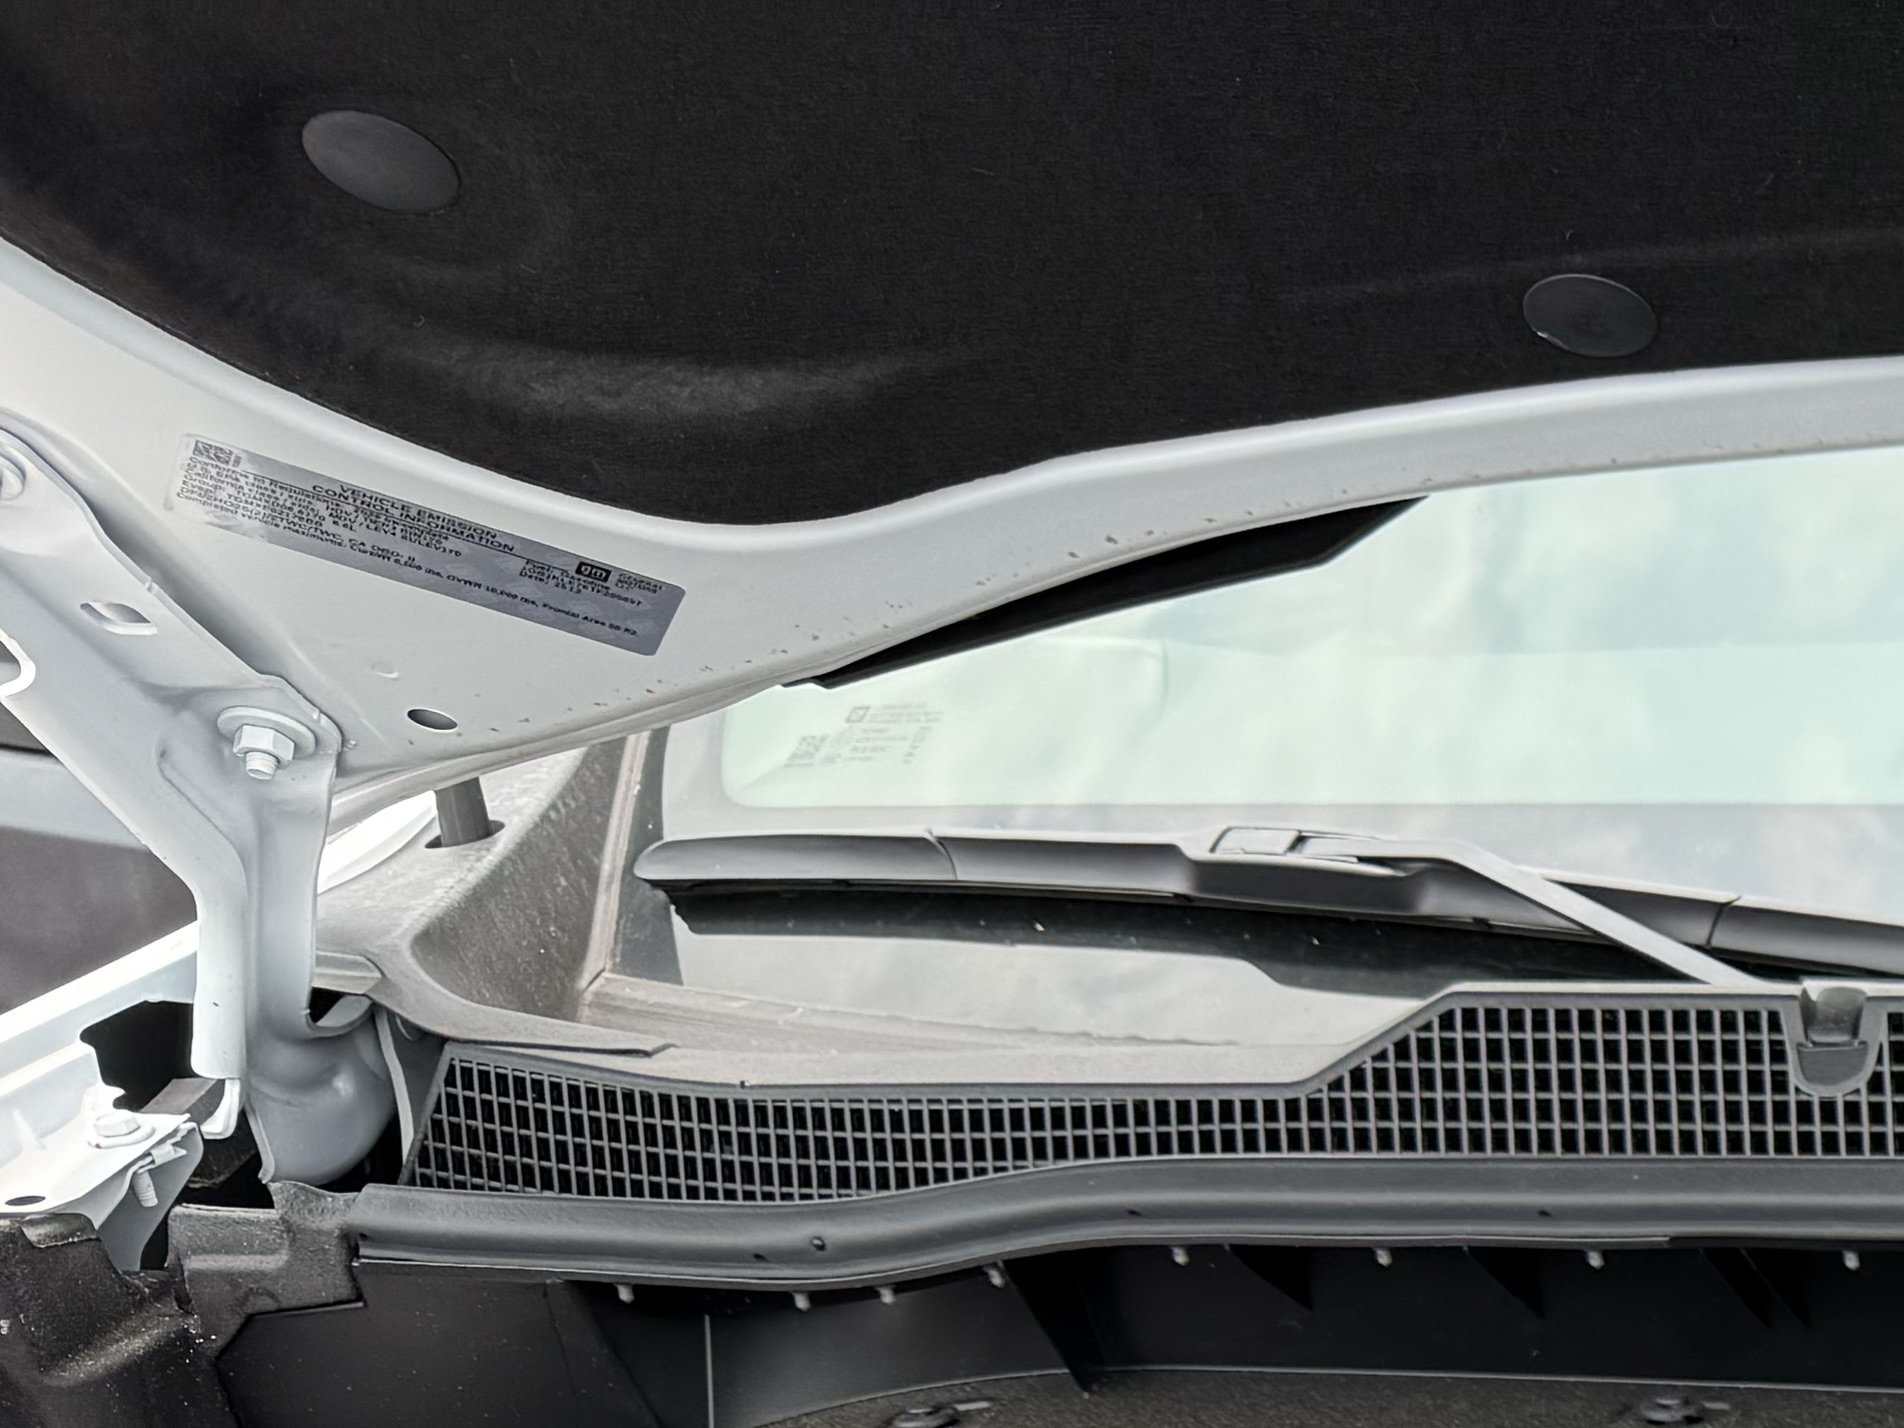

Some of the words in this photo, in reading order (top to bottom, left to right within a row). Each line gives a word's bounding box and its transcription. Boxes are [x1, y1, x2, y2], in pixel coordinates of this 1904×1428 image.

[310, 483, 397, 516] CONTROL
[398, 511, 516, 553] INFORMATION
[337, 483, 413, 513] VEHICLE
[414, 508, 498, 540] EMISSION
